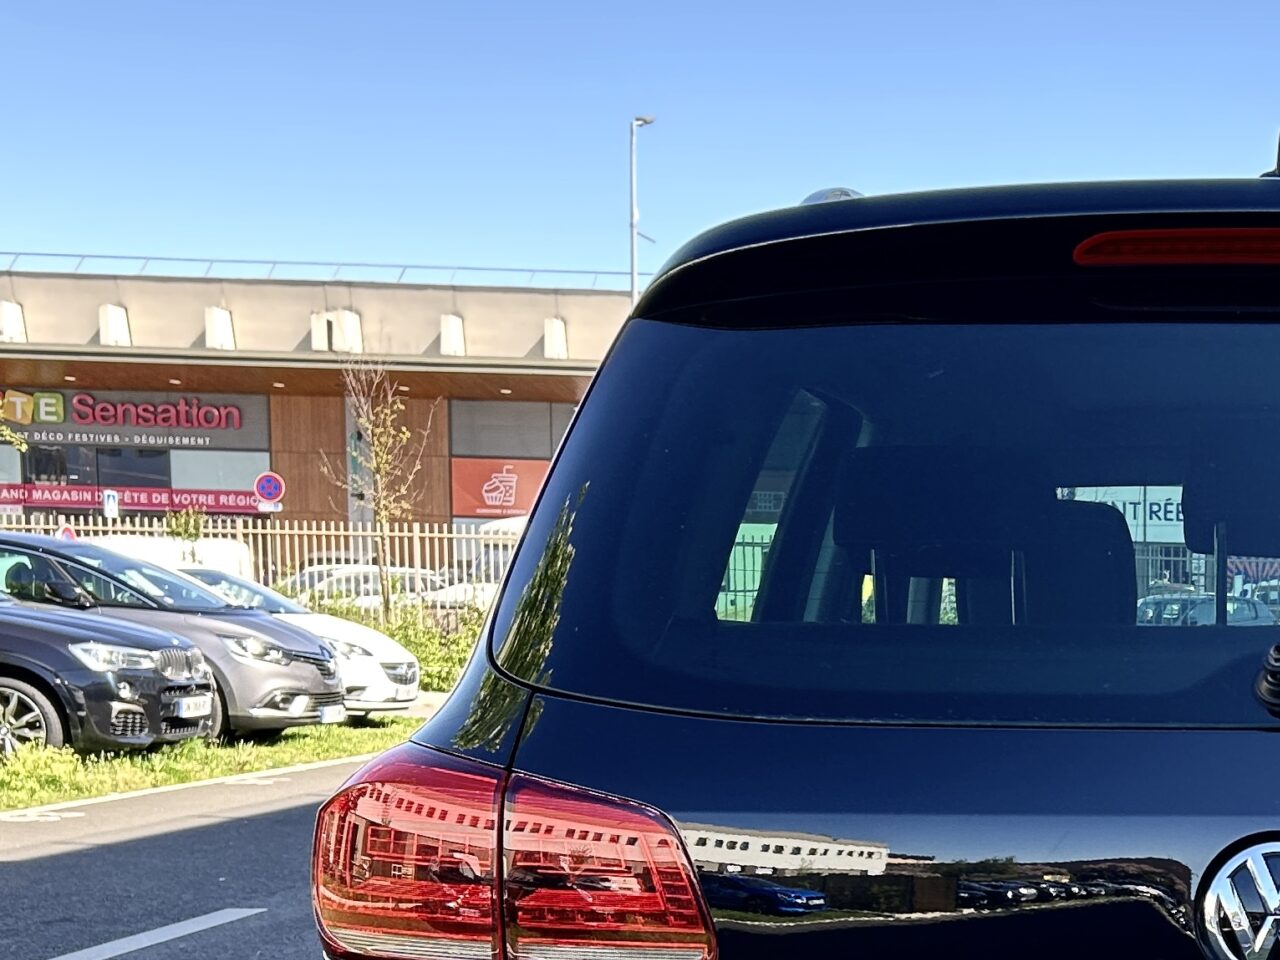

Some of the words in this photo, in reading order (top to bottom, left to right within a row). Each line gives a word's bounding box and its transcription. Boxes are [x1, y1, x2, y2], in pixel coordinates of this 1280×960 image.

[71, 392, 242, 429] Sensation
[34, 429, 64, 441] DÉCO
[68, 432, 120, 443] FESTIVES
[133, 433, 210, 445] DÉGUISEMENT
[32, 489, 92, 501] MAGASIN
[152, 492, 169, 504] DE
[172, 493, 215, 505] VOTRE
[219, 493, 259, 507] RÉGIO
